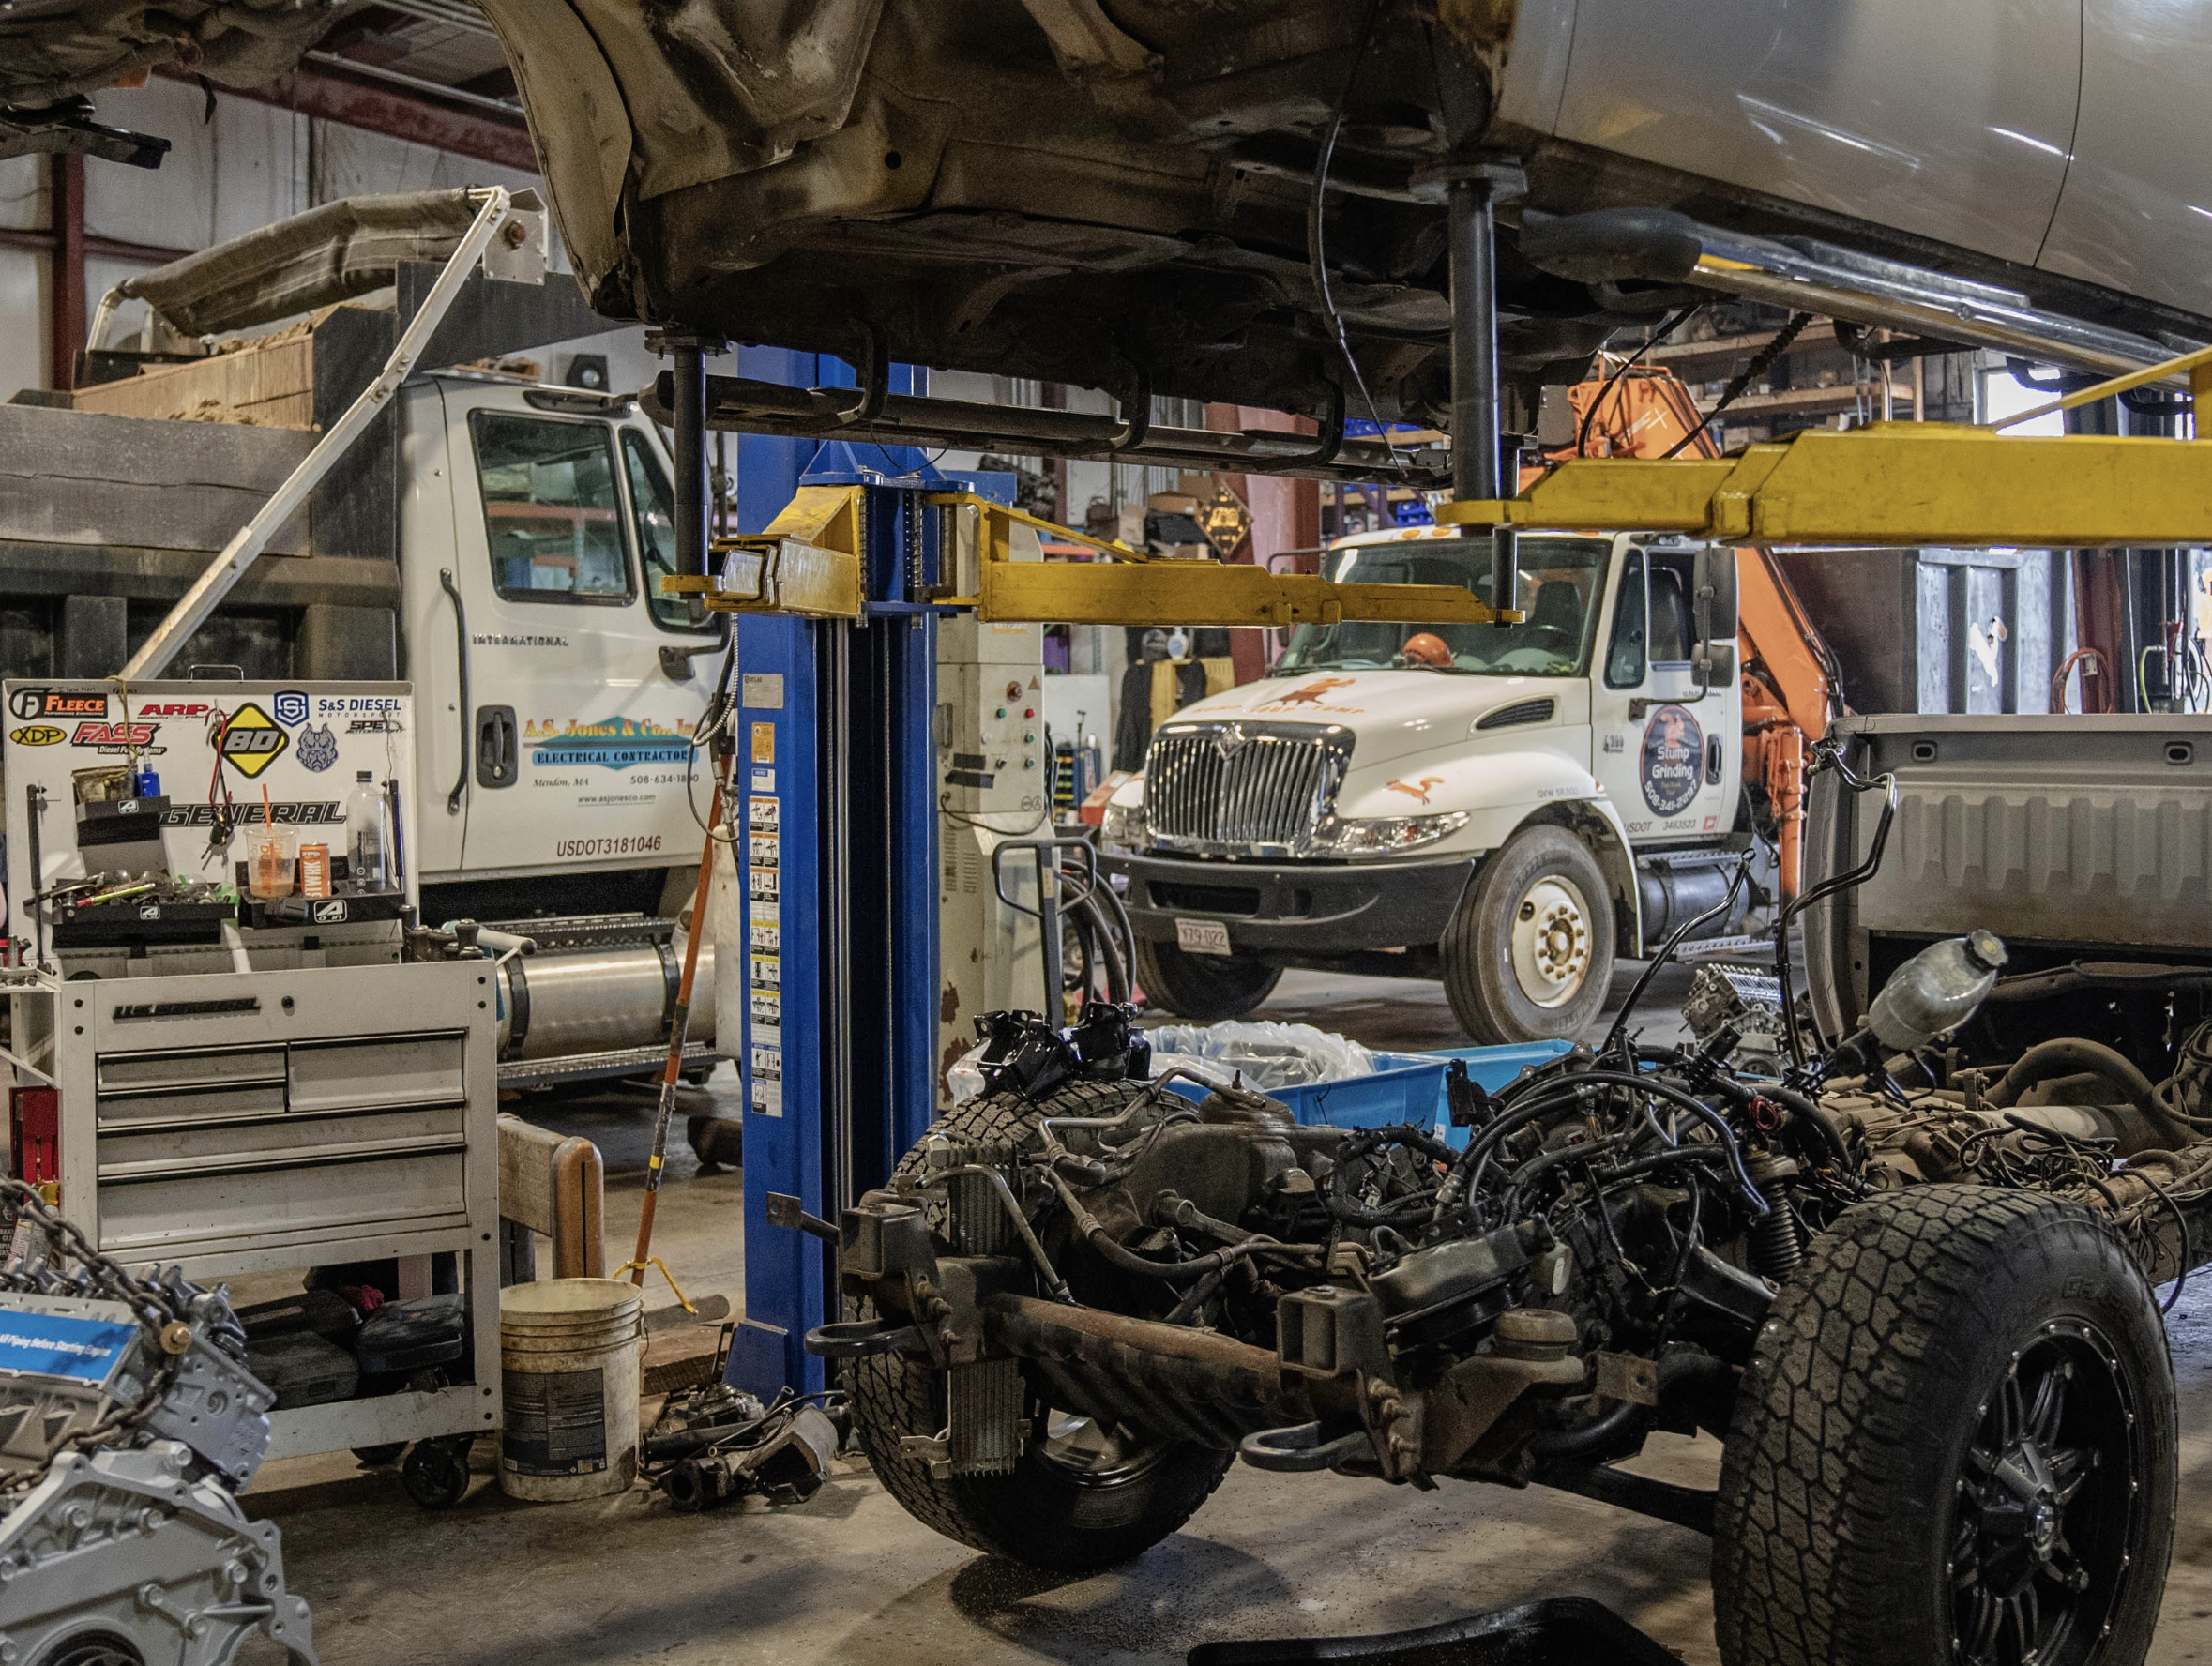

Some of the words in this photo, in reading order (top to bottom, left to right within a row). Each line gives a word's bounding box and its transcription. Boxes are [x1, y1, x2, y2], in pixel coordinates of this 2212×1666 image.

[473, 632, 568, 646] INTERNATIONAL
[45, 695, 105, 712] FLEECE
[139, 704, 208, 716] ARP
[319, 699, 345, 711] S&S
[350, 698, 401, 711] DIESEL
[16, 727, 61, 744] XDP
[73, 723, 156, 744] FASS
[565, 719, 616, 736] Jones
[621, 719, 635, 736] &
[224, 731, 280, 751] BD
[538, 751, 609, 764] ELECTRICAL
[1657, 746, 1689, 762] Stump
[1652, 764, 1693, 780] Grinding
[533, 778, 571, 787] Mendon,
[573, 778, 589, 786] MA
[578, 793, 657, 805] www.asjonesco.com
[159, 803, 347, 827] GENERAL
[556, 835, 662, 857] USDOT3181046
